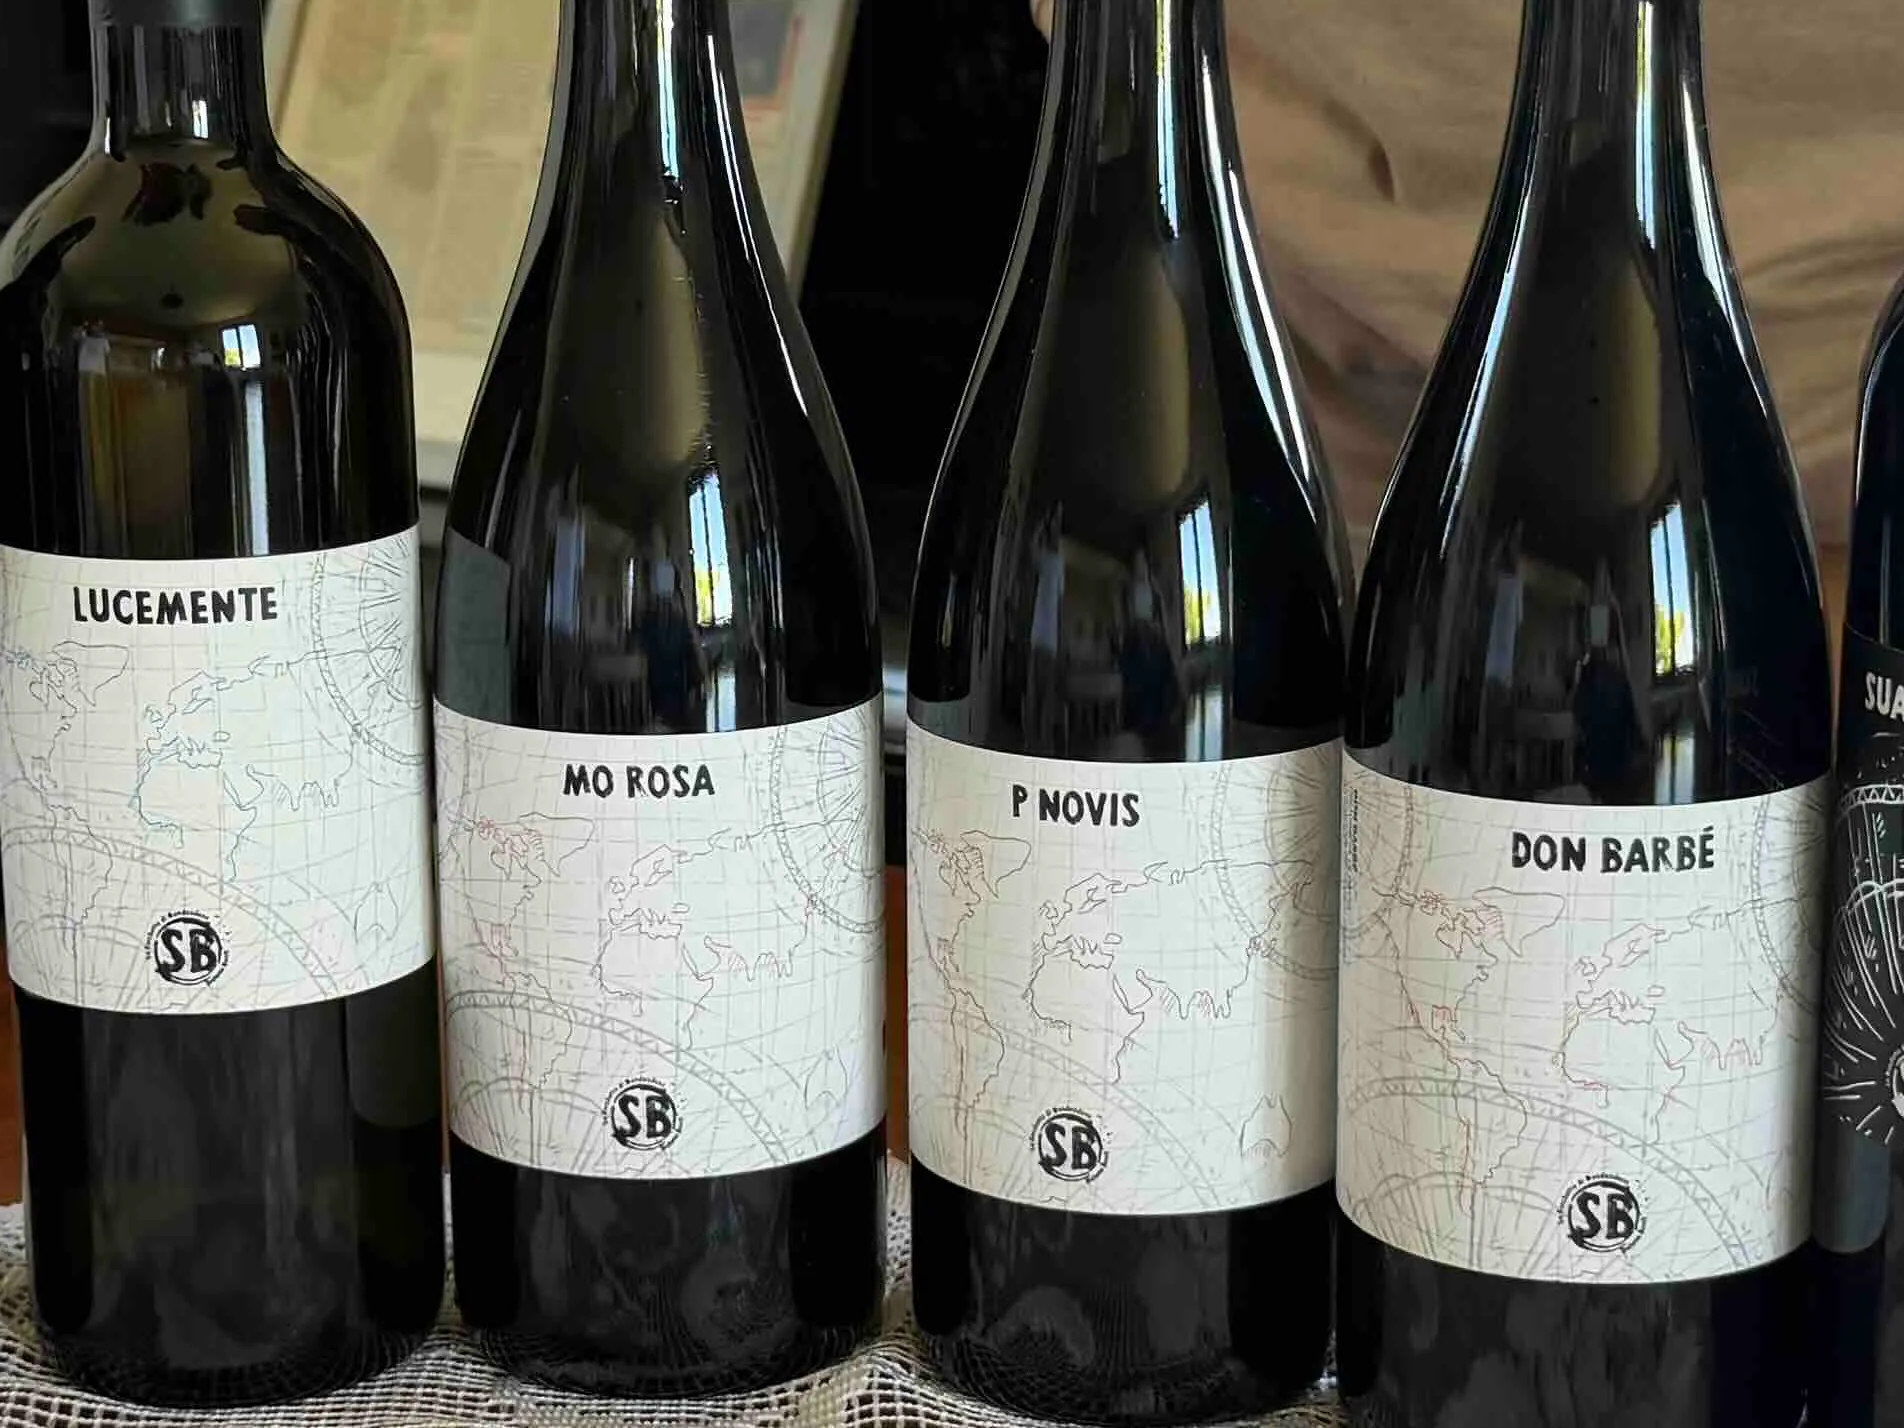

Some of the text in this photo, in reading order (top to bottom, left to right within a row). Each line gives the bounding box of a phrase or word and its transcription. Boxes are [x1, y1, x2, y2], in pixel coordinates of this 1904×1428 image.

[72, 585, 278, 625] LUCEMENTE
[562, 763, 716, 800] MO ROSA
[1010, 784, 1140, 828] P NOVIS
[1511, 825, 1716, 874] DON BARBÉ
[160, 928, 217, 974] SB
[618, 1093, 672, 1139] SB
[1044, 1122, 1098, 1171] SB
[1575, 1190, 1635, 1241] SB
